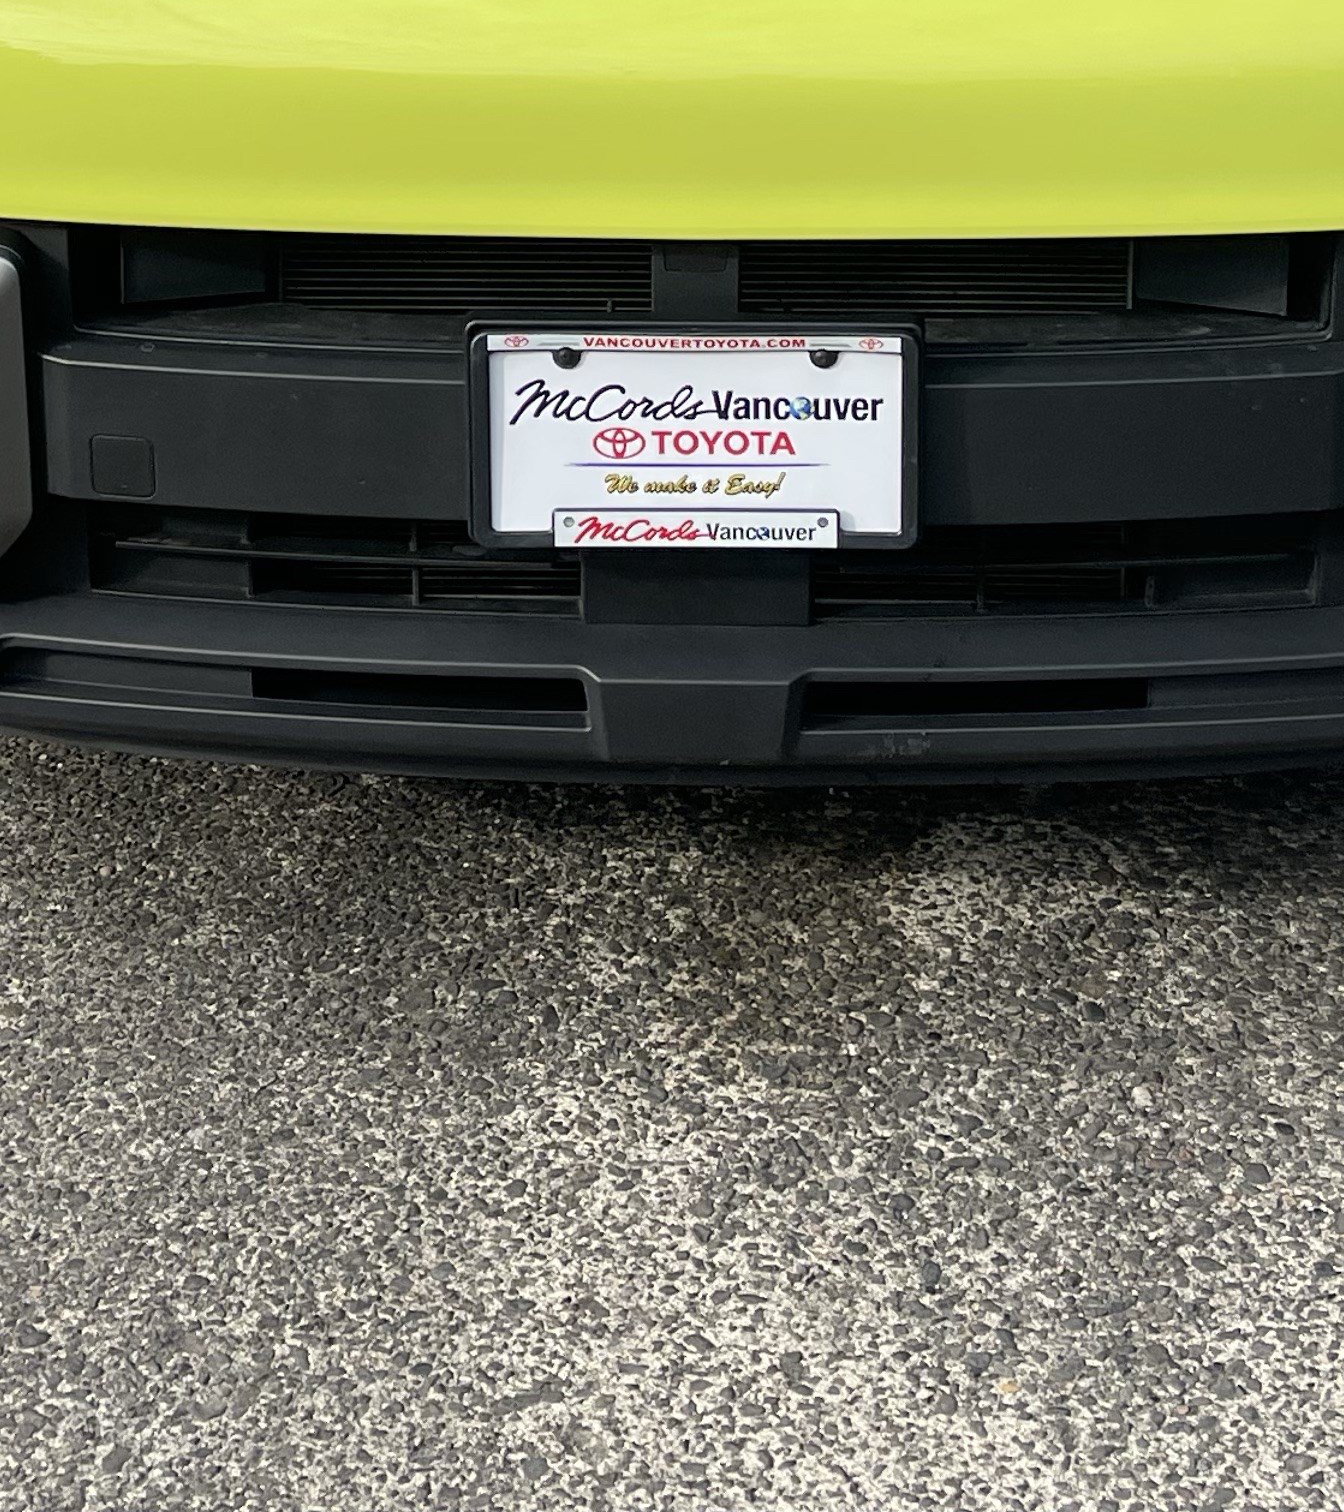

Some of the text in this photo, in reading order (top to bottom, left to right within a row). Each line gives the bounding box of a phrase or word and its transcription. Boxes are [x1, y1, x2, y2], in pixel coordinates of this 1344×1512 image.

[583, 337, 806, 349] VANCOUVERTOYOTA.COM
[509, 378, 884, 426] McCords Vancouver
[651, 430, 797, 456] TOYOTA
[604, 471, 787, 499] We make it Easy!
[574, 516, 817, 544] McCords Vancouver
